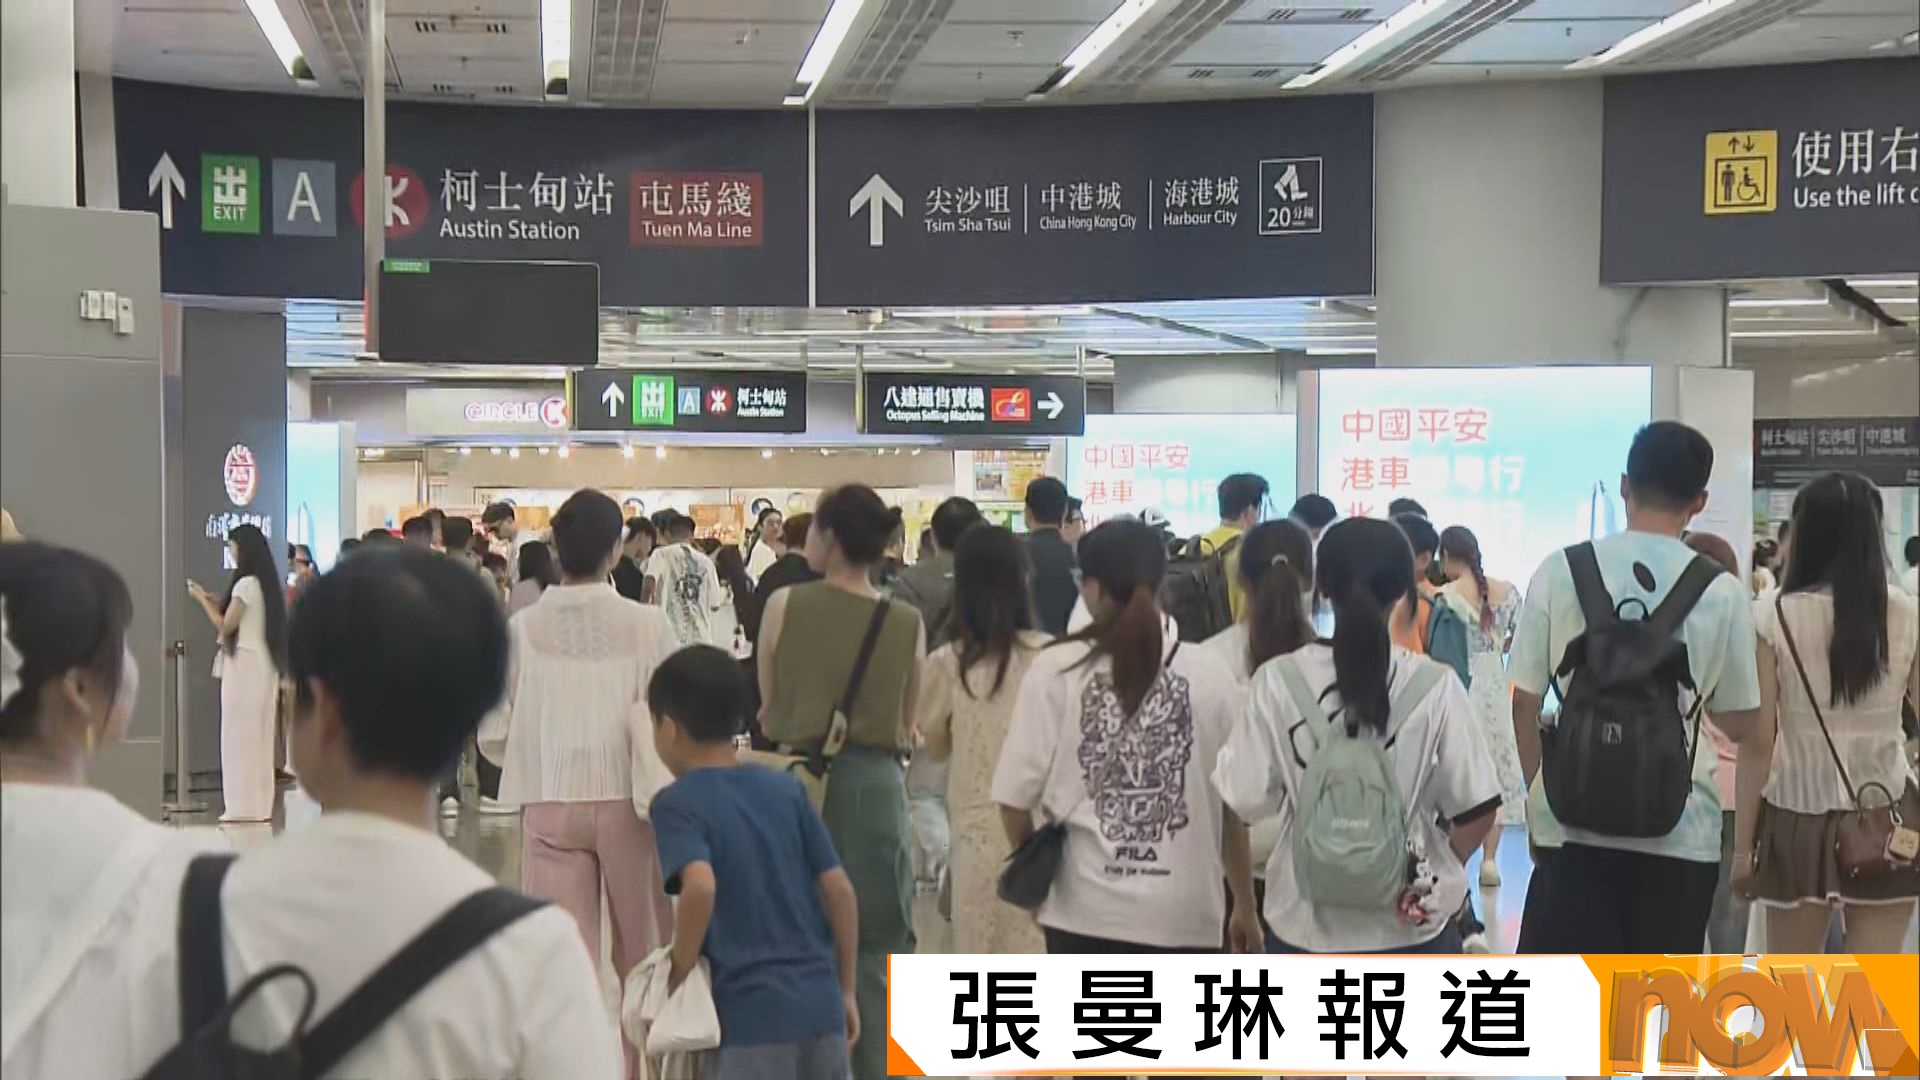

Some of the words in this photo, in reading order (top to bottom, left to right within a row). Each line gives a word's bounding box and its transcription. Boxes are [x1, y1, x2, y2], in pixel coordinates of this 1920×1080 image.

[1792, 126, 1919, 178] 使用右
[213, 166, 247, 204] 出
[440, 168, 614, 215] 柯士甸站
[1164, 176, 1239, 208] 海港城
[1794, 187, 1831, 208] Use
[1837, 184, 1870, 206] the
[1877, 182, 1905, 205] lift
[287, 171, 321, 223] A
[925, 185, 1010, 215] 尖沙咀
[1041, 181, 1121, 213] 中港城
[213, 204, 246, 220] EXIT
[1039, 215, 1066, 230] China
[1067, 215, 1093, 231] Hong
[1093, 215, 1118, 231] Kong
[1118, 213, 1137, 231] City
[1163, 211, 1212, 226] Harbour
[1213, 209, 1238, 227] City
[1267, 206, 1291, 228] 20
[439, 218, 503, 239] Austin
[508, 219, 580, 240] Station
[642, 220, 683, 237] Tuen
[687, 221, 713, 237] Ma
[717, 221, 752, 238] Line
[924, 218, 955, 232] Tsim
[958, 217, 983, 232] Sha
[985, 217, 1011, 231] Tsui
[683, 393, 696, 412] A
[886, 409, 921, 422] Octopus
[1342, 407, 1489, 443] 中國平安
[1114, 846, 1158, 861] FILA
